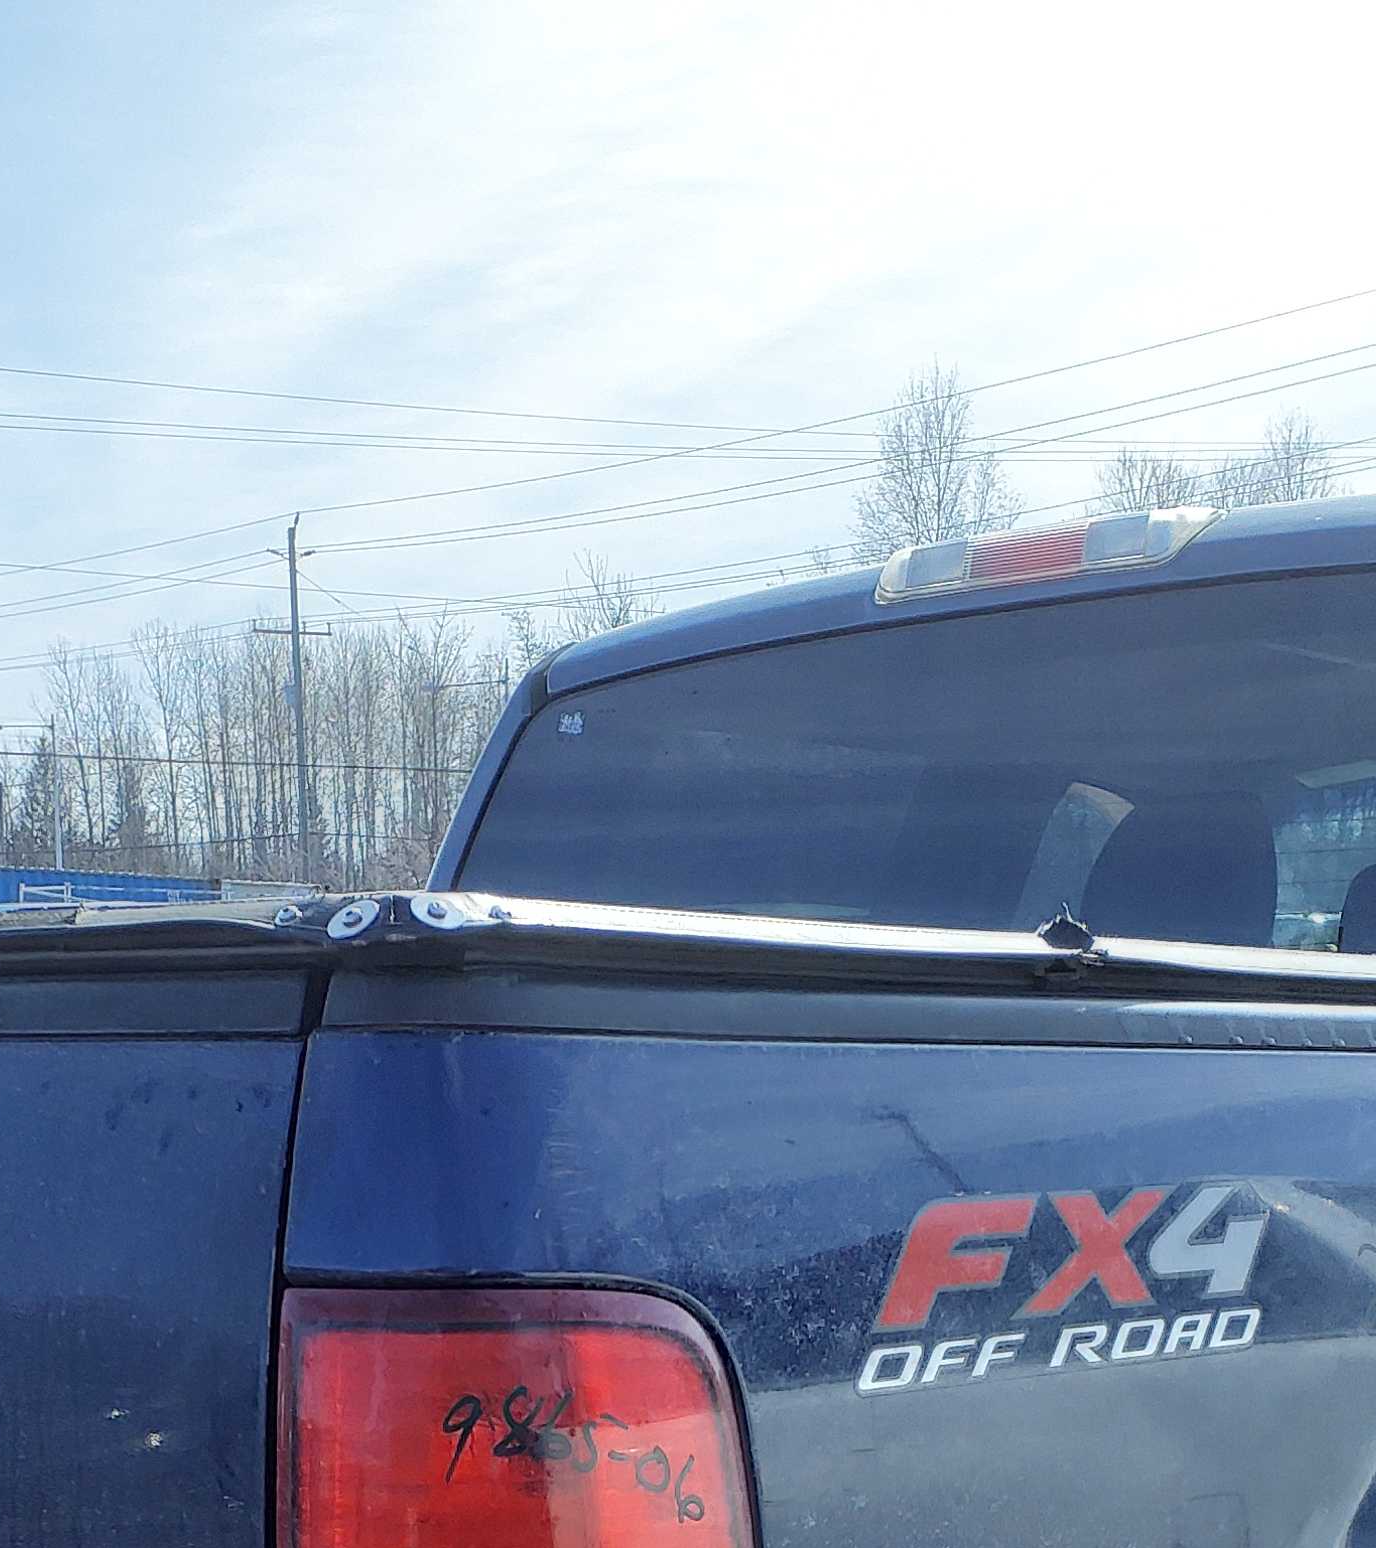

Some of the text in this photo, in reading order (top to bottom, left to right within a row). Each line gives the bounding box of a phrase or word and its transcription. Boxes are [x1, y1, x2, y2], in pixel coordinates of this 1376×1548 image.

[874, 1180, 1270, 1332] FX4
[856, 1306, 1262, 1393] OFF ROAD
